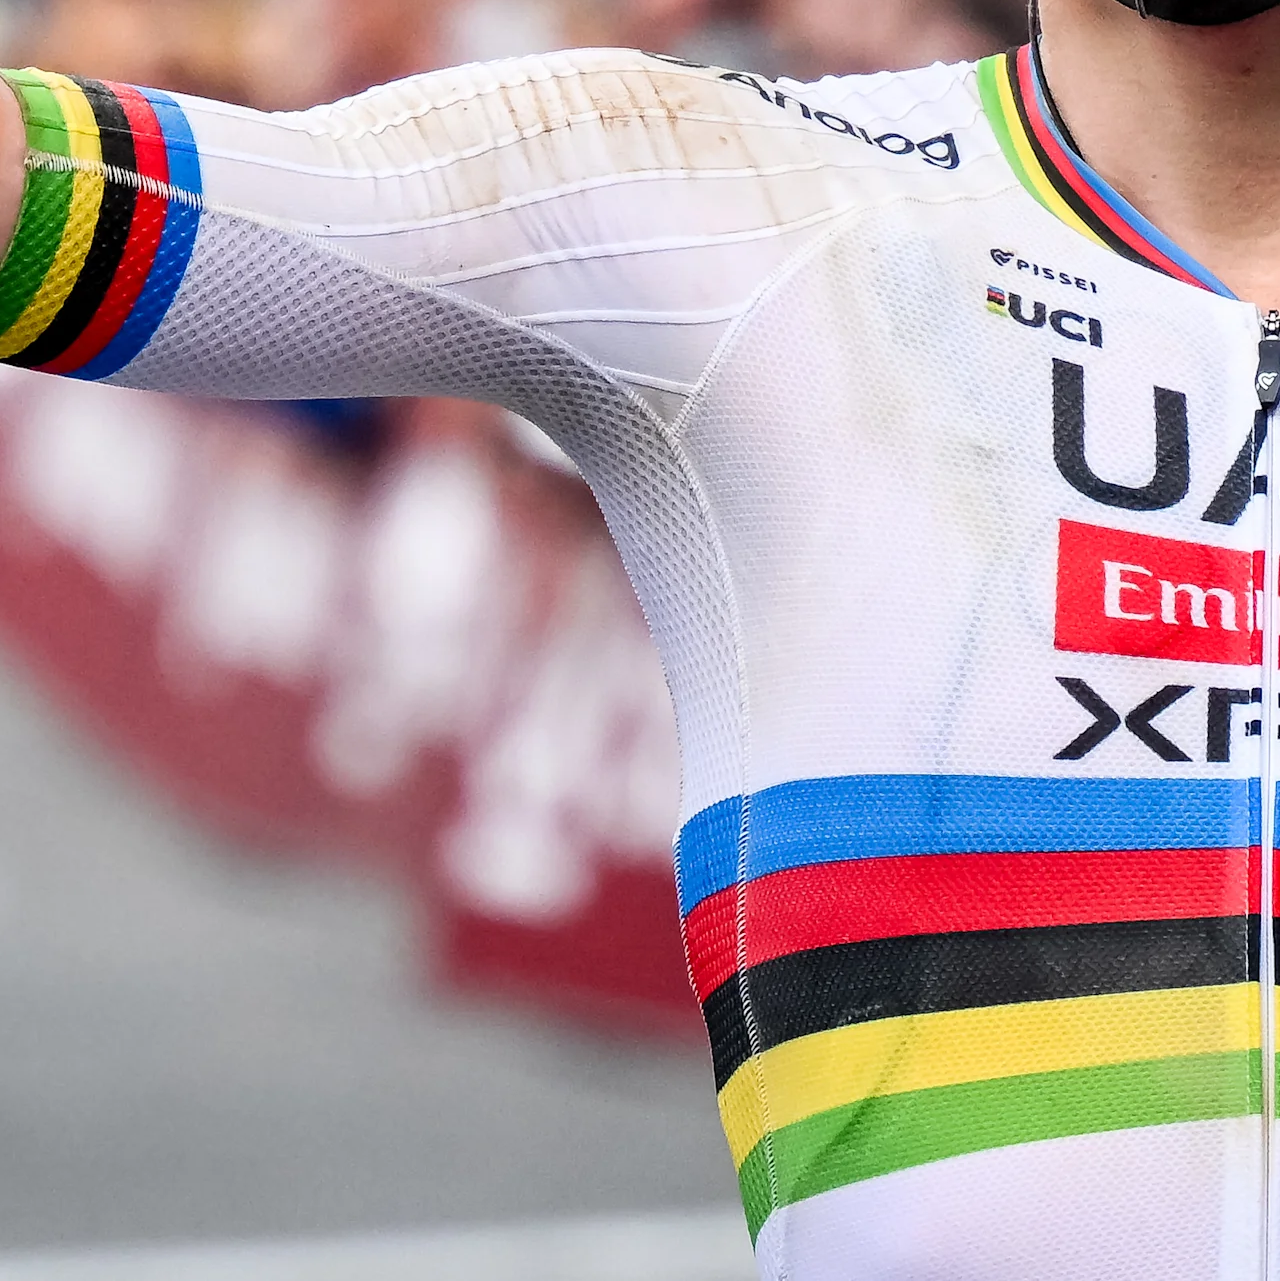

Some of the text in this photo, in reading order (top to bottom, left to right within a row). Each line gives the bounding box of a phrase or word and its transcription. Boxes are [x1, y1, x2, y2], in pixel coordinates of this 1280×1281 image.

[720, 72, 960, 169] Analog
[1016, 259, 1097, 293] PISSEI
[1008, 292, 1102, 348] UCI
